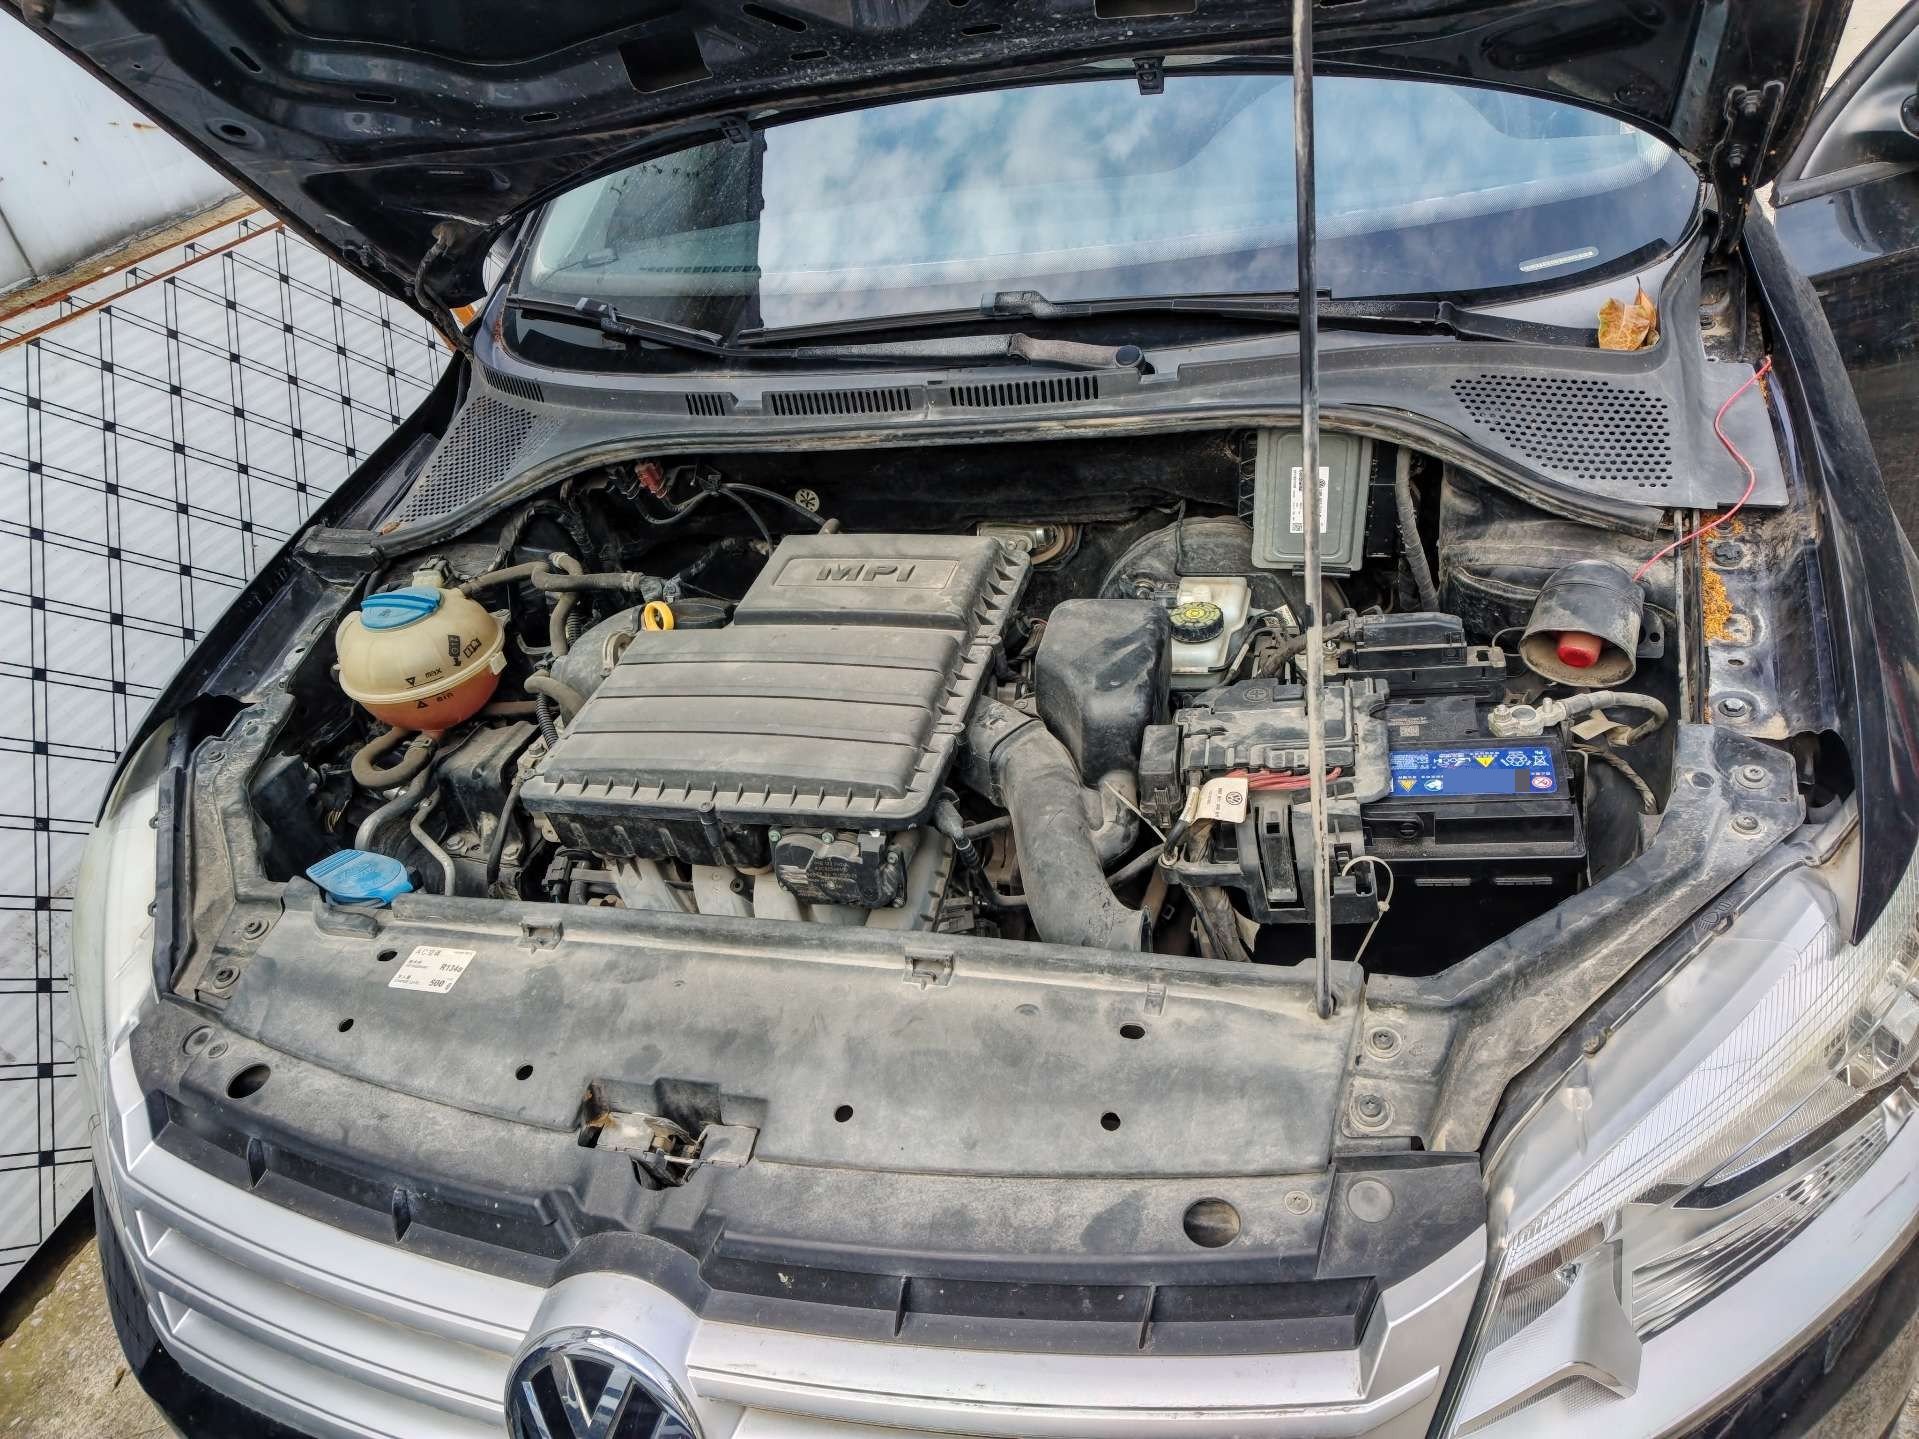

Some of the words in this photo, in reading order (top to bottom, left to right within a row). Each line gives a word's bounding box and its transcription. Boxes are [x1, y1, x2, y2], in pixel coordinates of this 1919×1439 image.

[815, 563, 916, 582] MPI
[425, 668, 442, 678] max
[428, 979, 446, 987] 500
